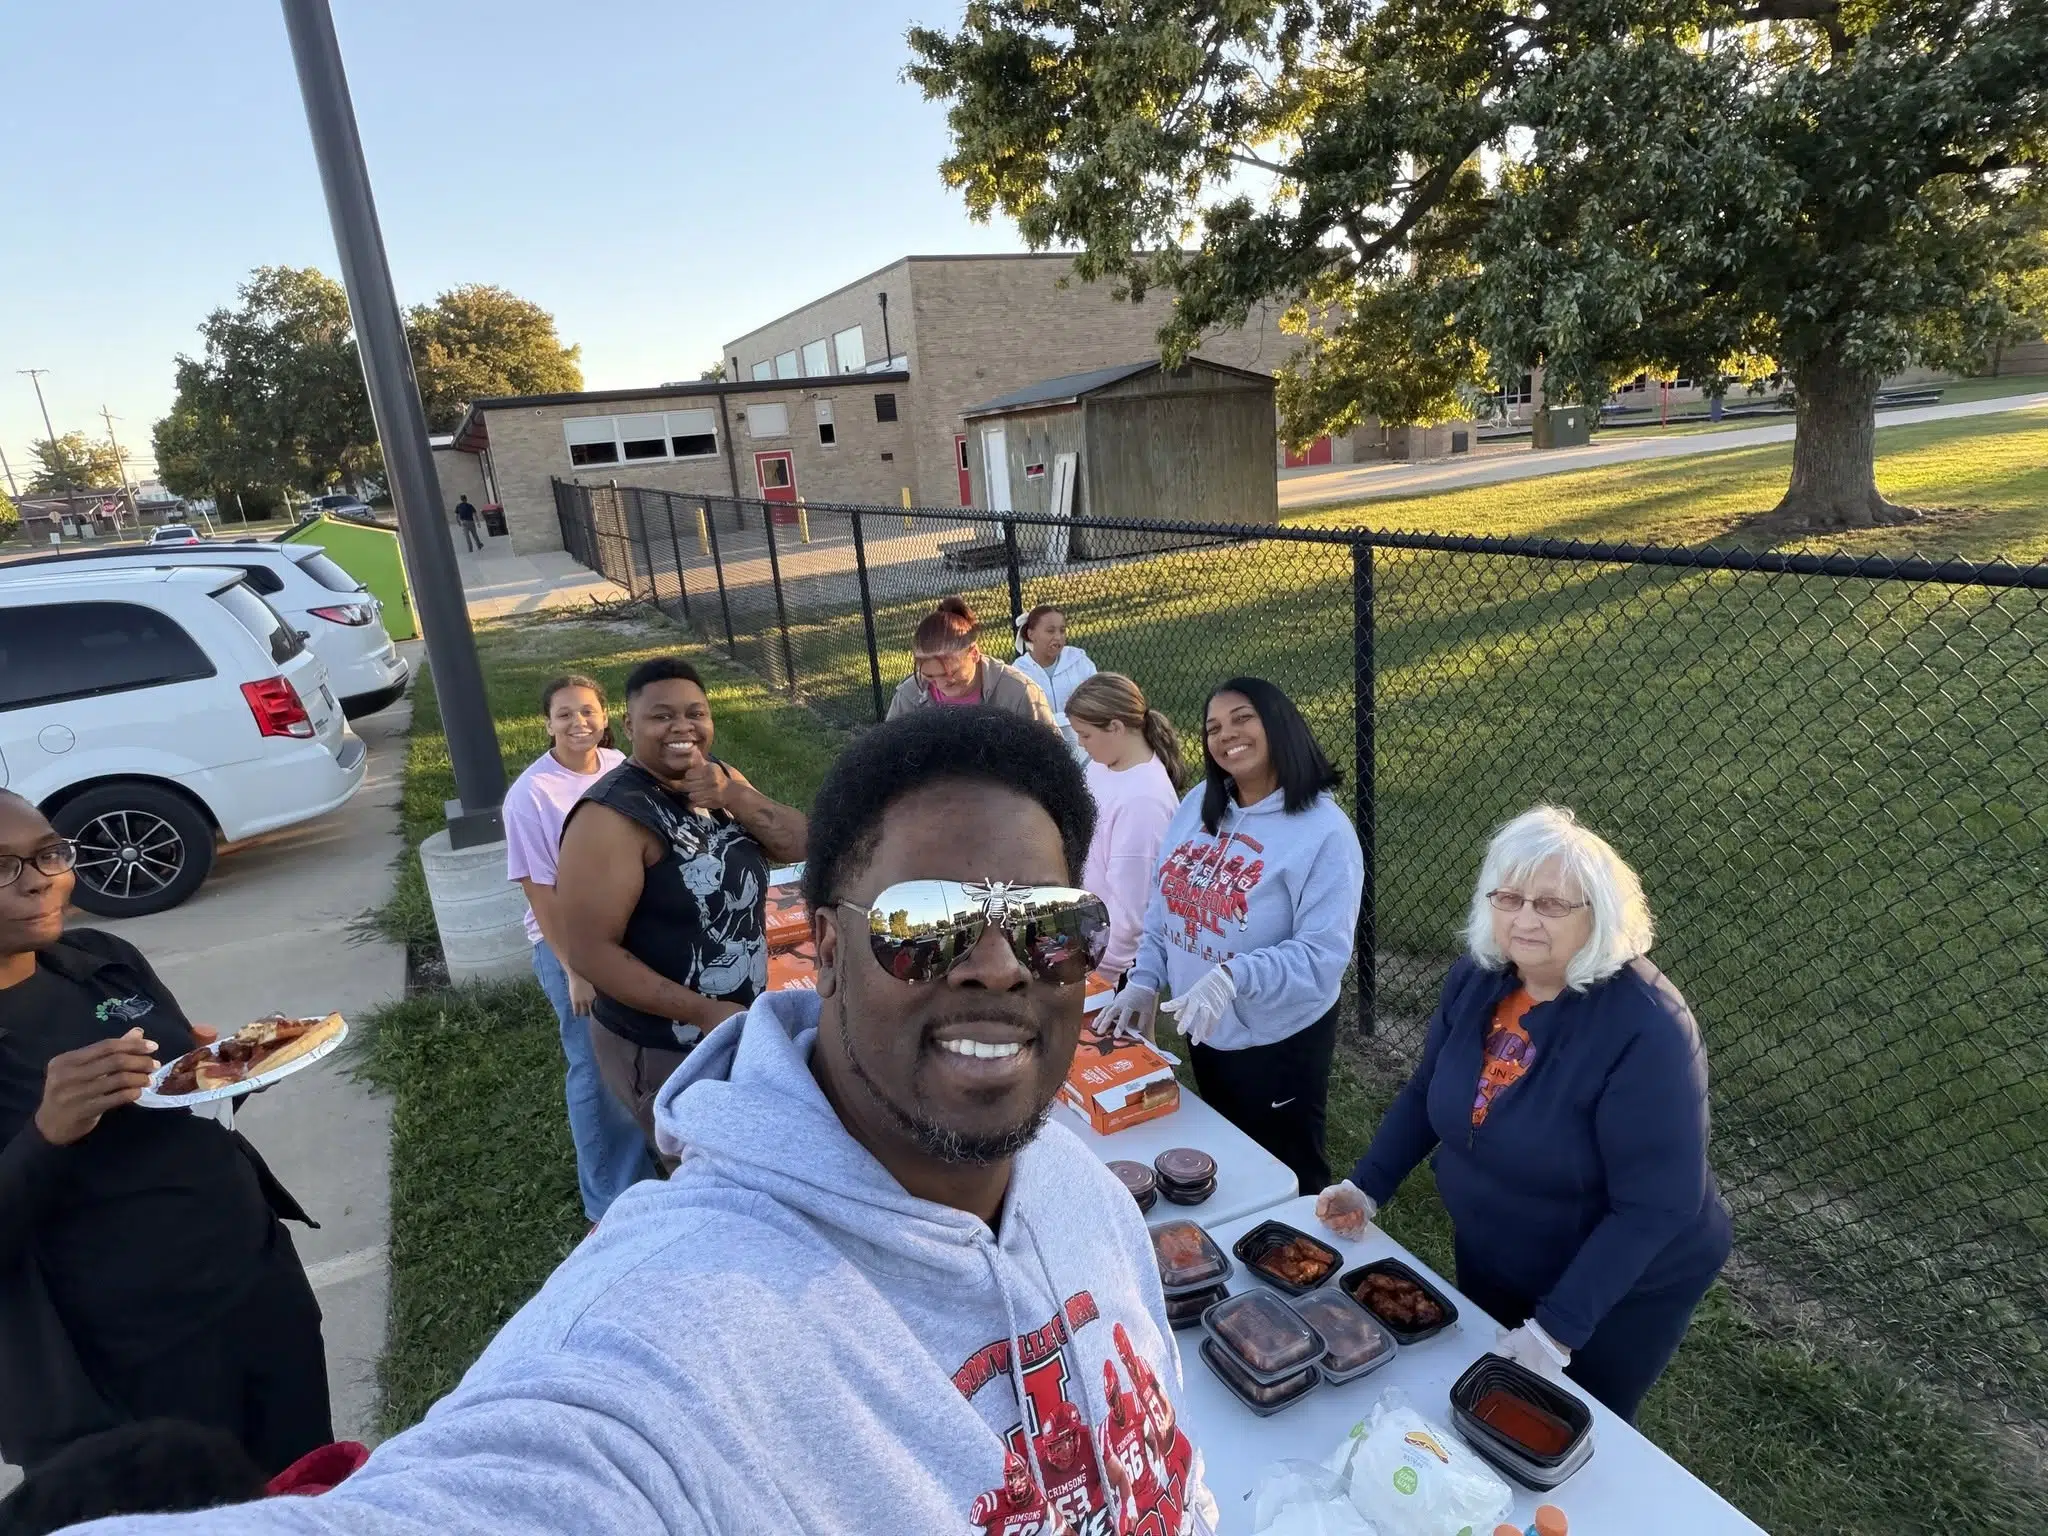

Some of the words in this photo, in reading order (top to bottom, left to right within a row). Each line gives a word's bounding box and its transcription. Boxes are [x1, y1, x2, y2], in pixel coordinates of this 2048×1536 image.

[1166, 896, 1226, 938] WALL
[1119, 1440, 1144, 1485] 56
[1047, 1472, 1087, 1500] CRIMSONS
[1055, 1485, 1092, 1526] 53
[1003, 1509, 1042, 1526] CRIMSONS
